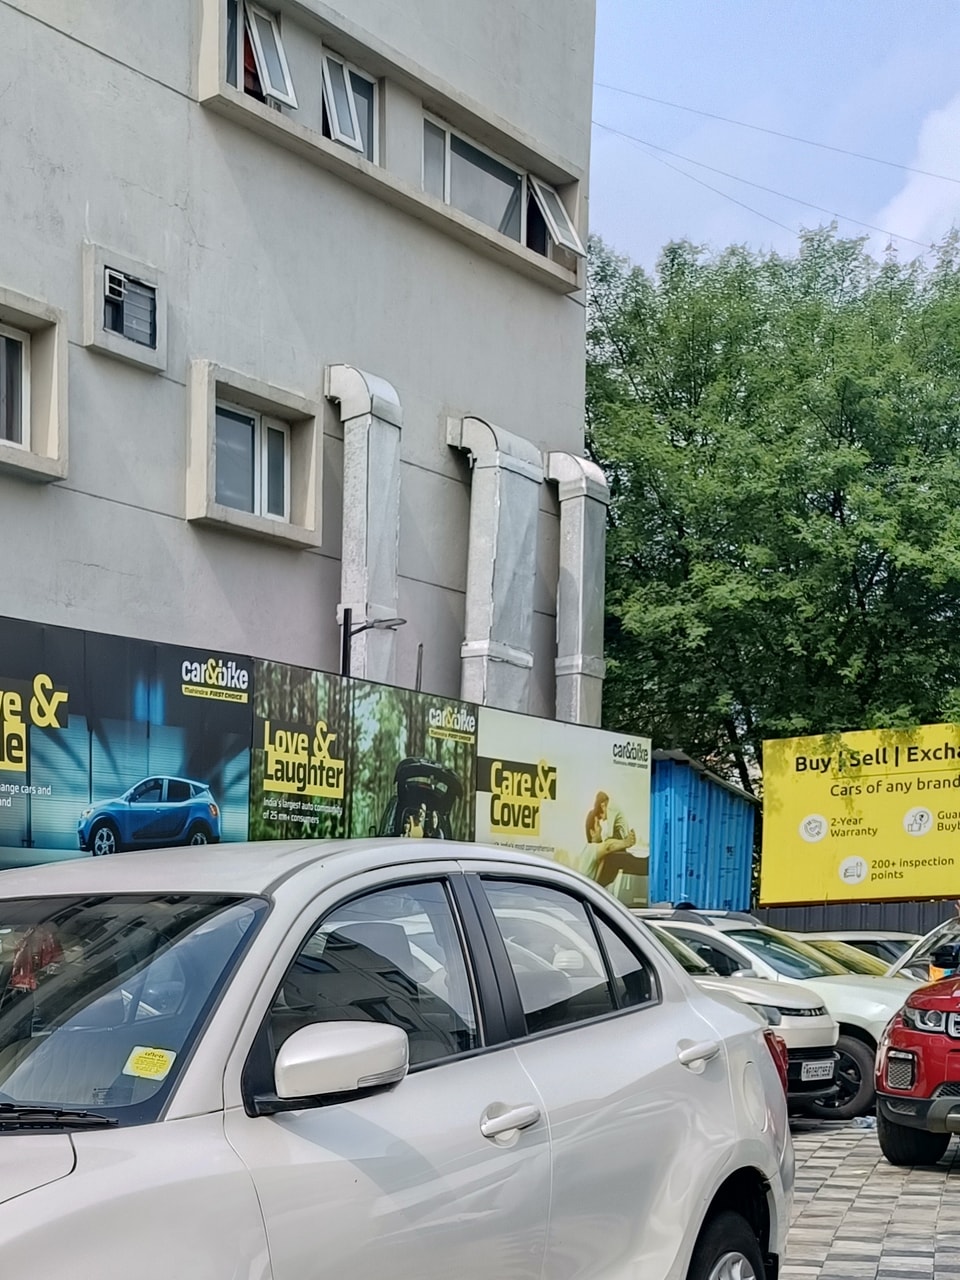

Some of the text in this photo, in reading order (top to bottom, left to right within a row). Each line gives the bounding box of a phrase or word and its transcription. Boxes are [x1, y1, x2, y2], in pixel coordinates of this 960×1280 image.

[182, 658, 248, 690] car&bike
[30, 673, 68, 728] &
[225, 693, 243, 701] CHOICE
[429, 706, 475, 732] car&bike
[265, 720, 336, 759] Love &
[613, 741, 648, 762] car&bike
[795, 756, 831, 773] Buy
[850, 747, 888, 767] Sell
[264, 750, 343, 792] Laughter
[491, 759, 556, 800] Care &
[21, 785, 36, 794] cars
[37, 785, 52, 795] and
[830, 777, 960, 796] Cars of any brand
[263, 797, 281, 808] India's
[282, 799, 301, 810] largest
[490, 793, 539, 829] Cover
[263, 810, 269, 819] of
[831, 817, 863, 827] 2-Year
[937, 810, 960, 820] Gua
[830, 827, 878, 837] Warranty
[871, 856, 954, 869] 200+ inspection
[871, 870, 904, 881] points
